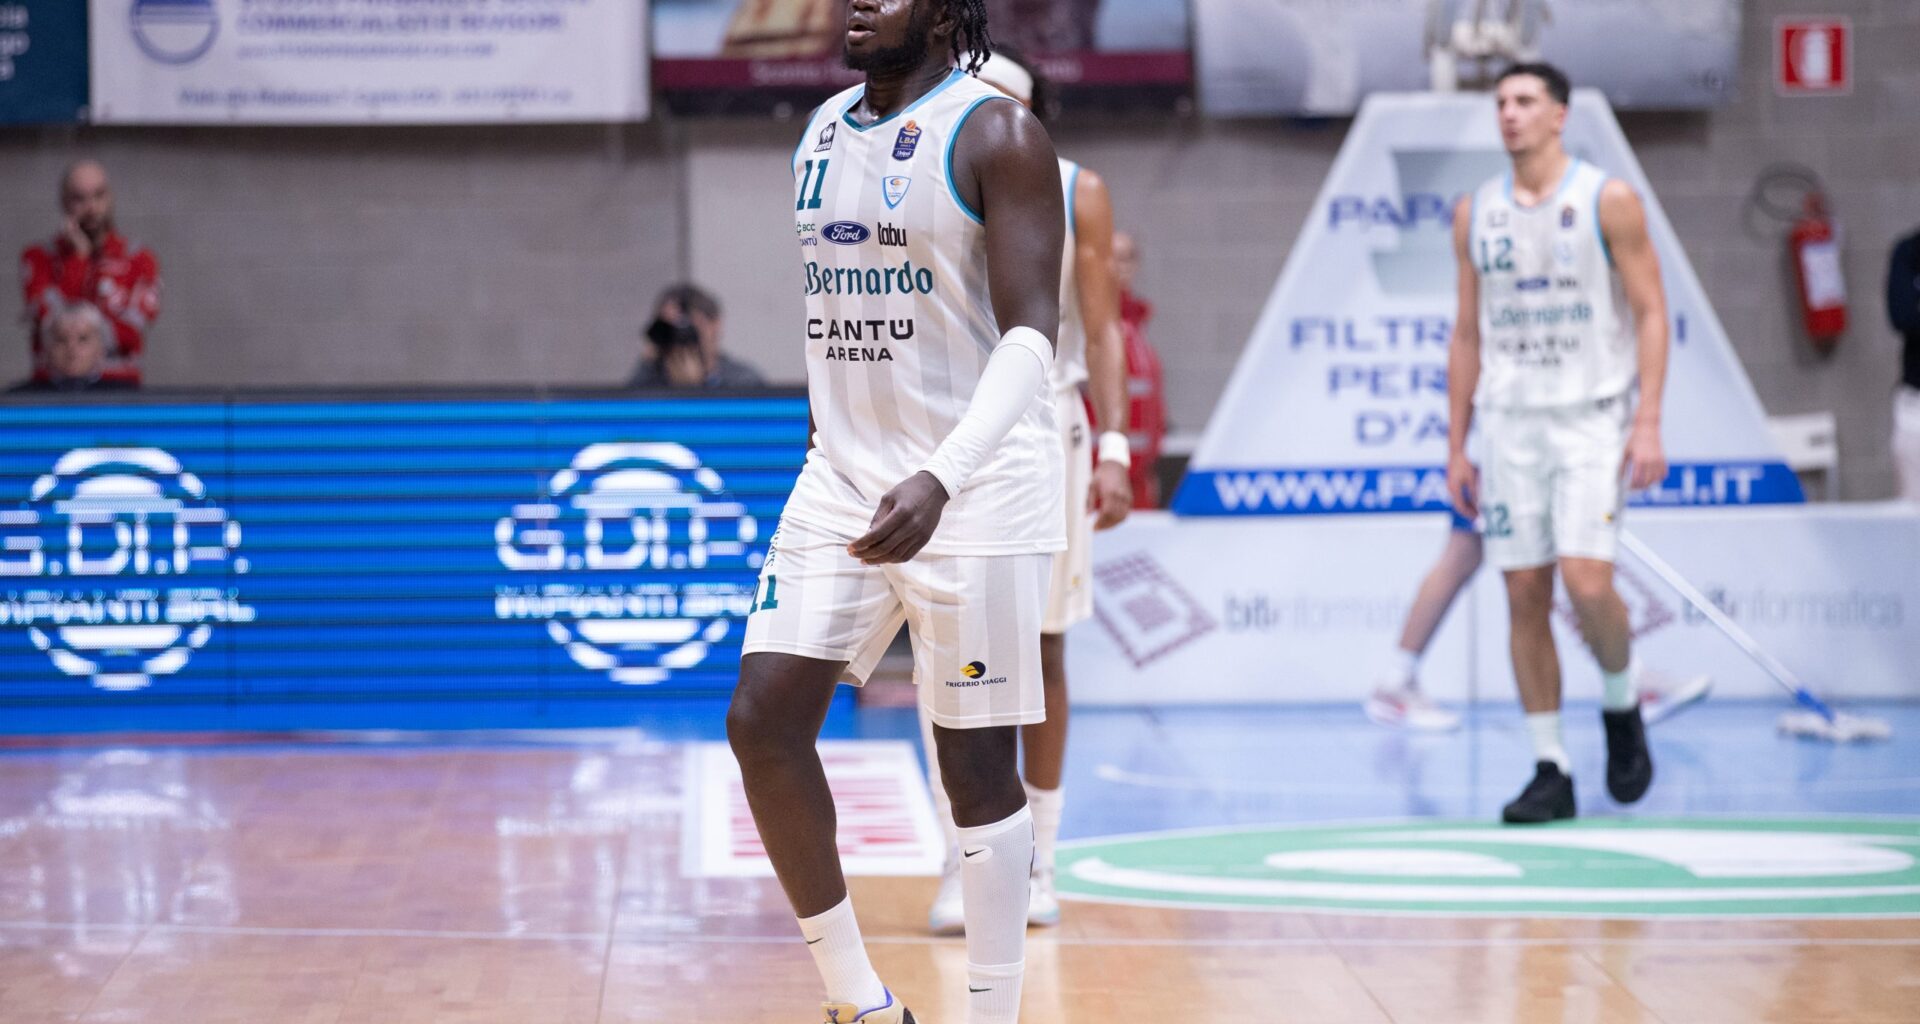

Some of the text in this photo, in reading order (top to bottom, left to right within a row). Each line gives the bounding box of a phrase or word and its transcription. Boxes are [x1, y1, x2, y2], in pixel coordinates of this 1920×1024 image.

[898, 136, 916, 145] LBA
[796, 159, 830, 211] 11
[802, 223, 816, 232] BCC
[831, 224, 861, 241] Ford
[877, 222, 907, 246] tabu
[1480, 236, 1516, 273] 12
[1290, 317, 1450, 350] FILTR
[826, 346, 894, 362] ARENA
[1355, 411, 1450, 445] D'A
[0, 587, 159, 625] MPIANTI
[681, 582, 758, 616] SR
[981, 676, 1007, 686] VIAGGI
